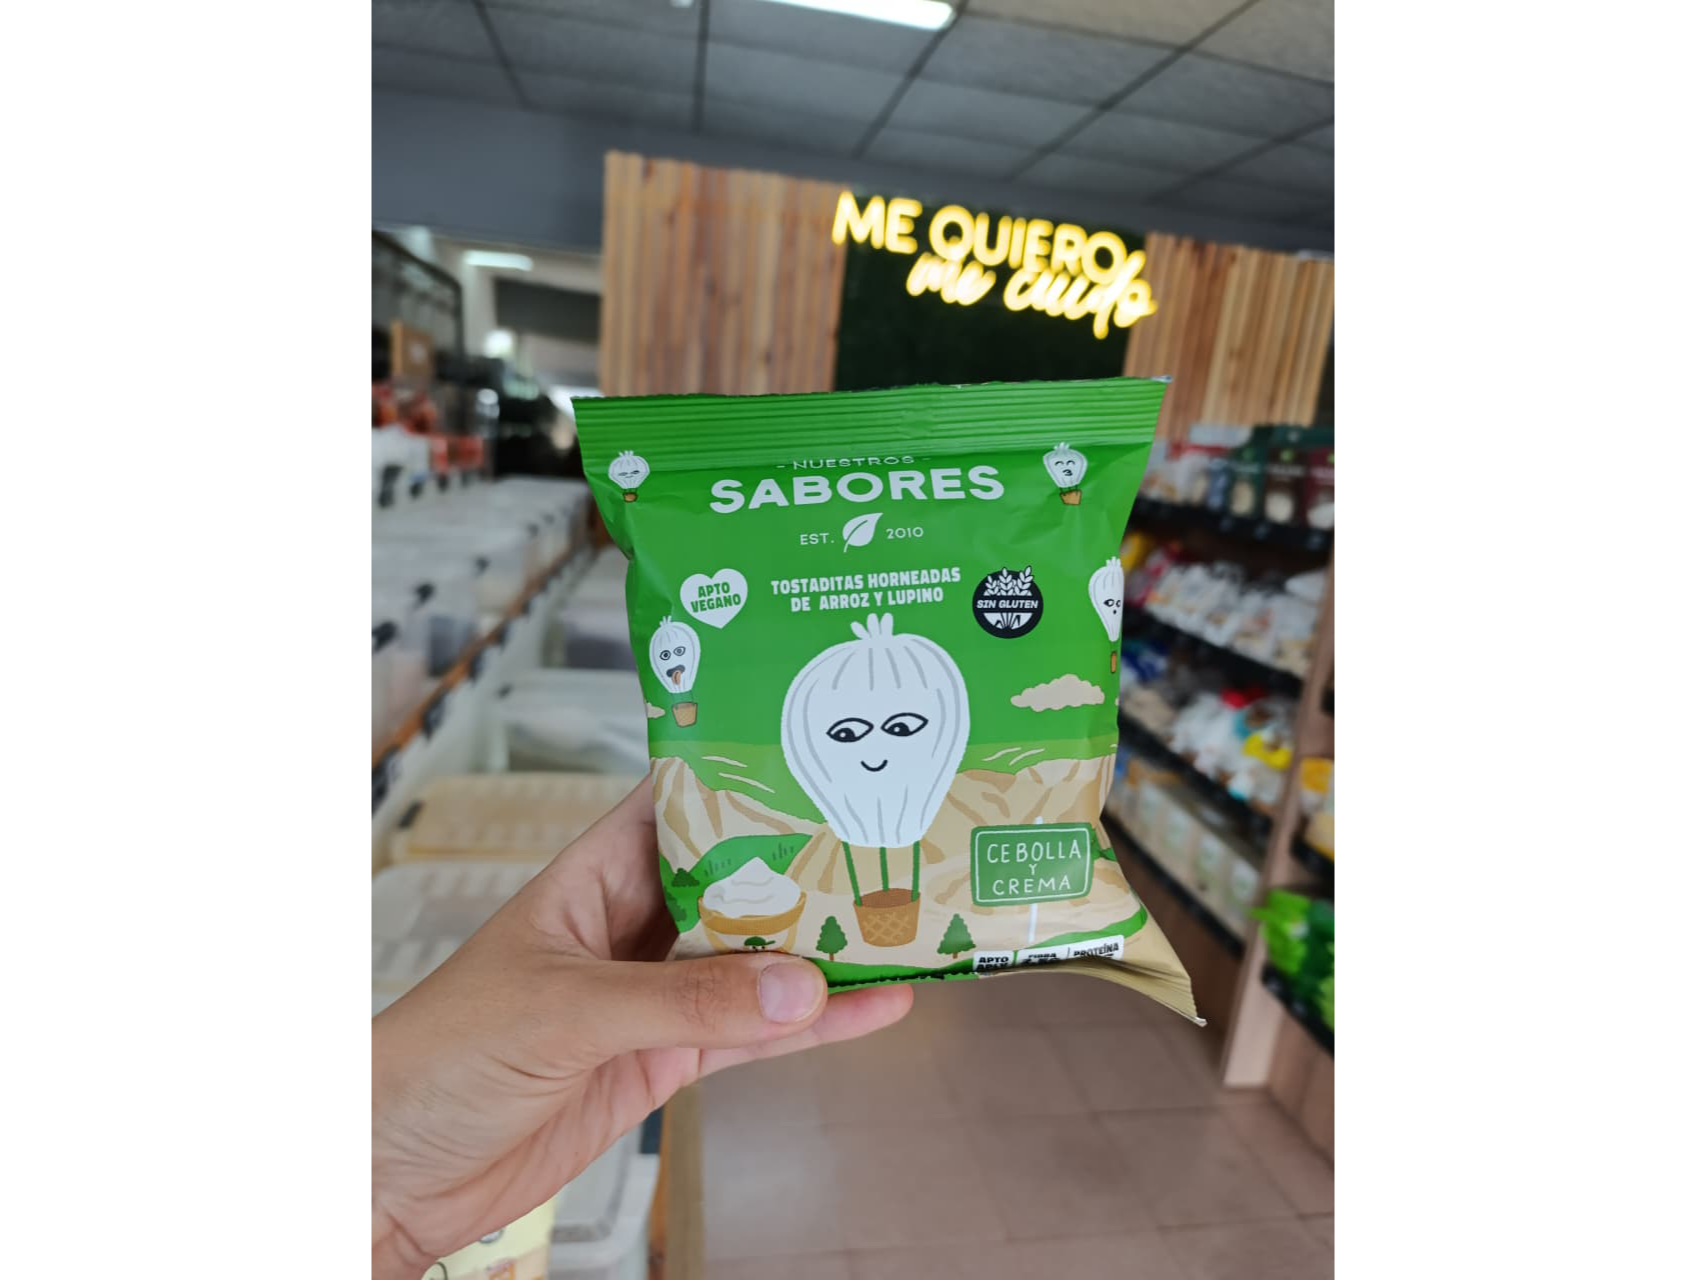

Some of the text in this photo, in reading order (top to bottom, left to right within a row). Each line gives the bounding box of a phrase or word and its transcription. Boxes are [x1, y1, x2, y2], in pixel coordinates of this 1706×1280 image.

[832, 191, 1127, 285] ME QUIERO
[906, 252, 997, 306] me
[792, 455, 915, 470] NUESTROS
[709, 465, 1005, 514] SABORES
[800, 526, 924, 545] EST. 2010
[698, 581, 730, 598] APTO
[771, 567, 961, 595] TOSTADITAS HORNEADAS
[690, 593, 741, 613] VEGANO
[790, 587, 944, 612] DE ARROZ Y LUPINO
[976, 599, 1039, 609] SIN GLUTEN
[986, 839, 1082, 864] CEBOLLA
[1028, 863, 1038, 876] Y
[992, 875, 1072, 896] CREMA
